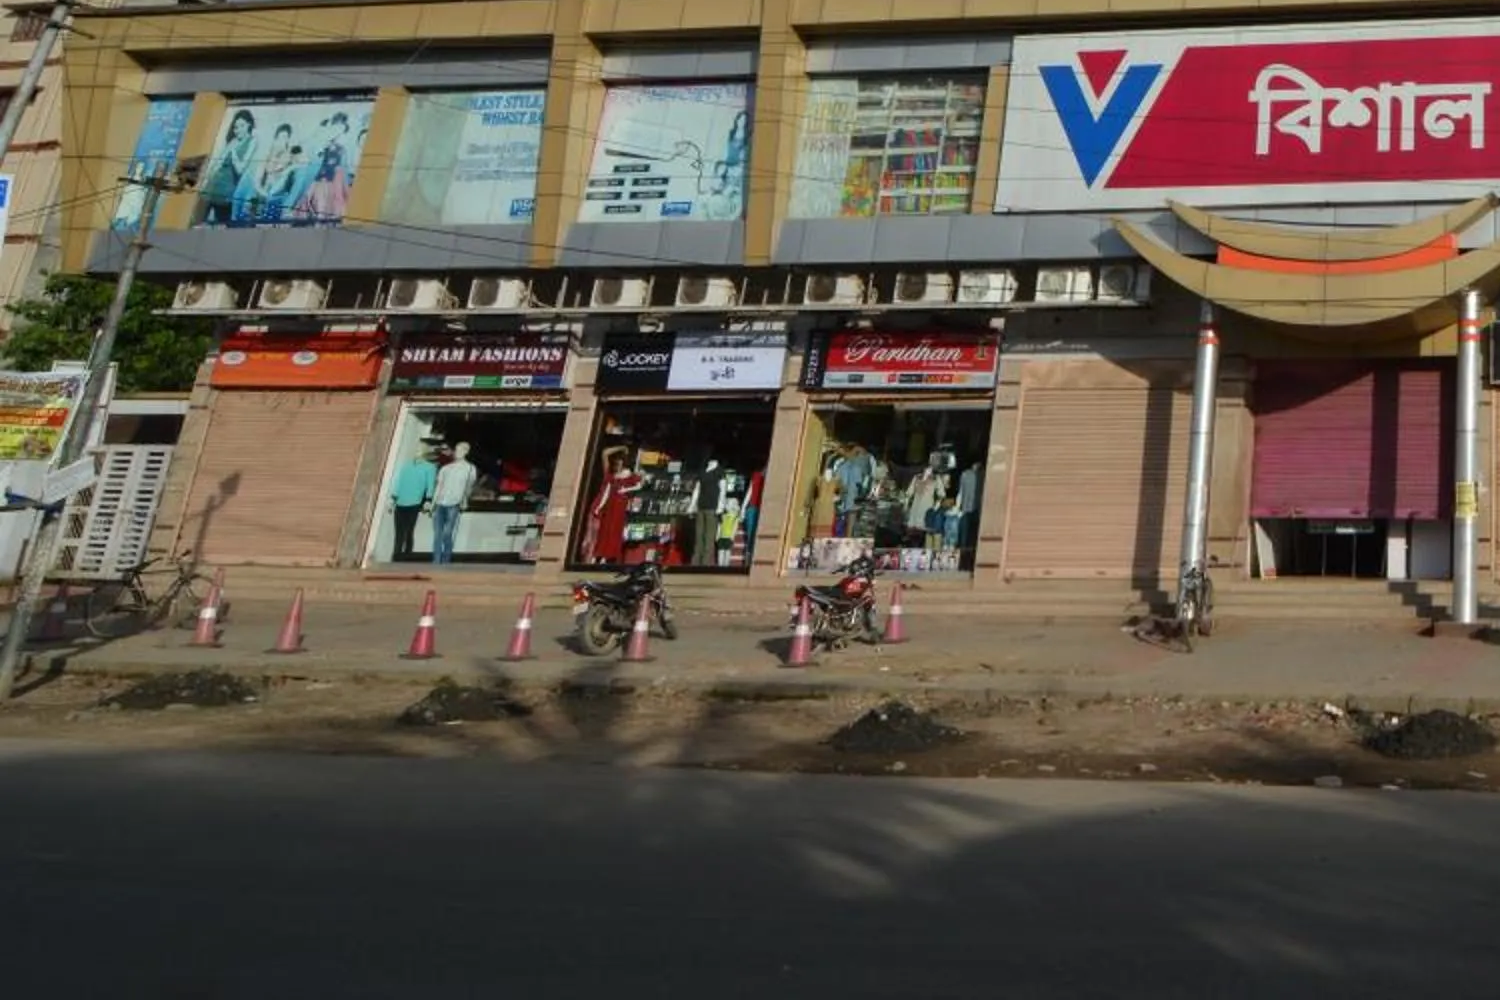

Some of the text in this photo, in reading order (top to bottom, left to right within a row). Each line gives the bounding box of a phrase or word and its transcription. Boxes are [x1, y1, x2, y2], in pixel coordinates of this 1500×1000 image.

[1248, 63, 1492, 155] বিশাল
[401, 346, 563, 363] SHYAM FASHIONS
[619, 352, 670, 365] JOCKEY
[843, 334, 963, 364] Paridhan
